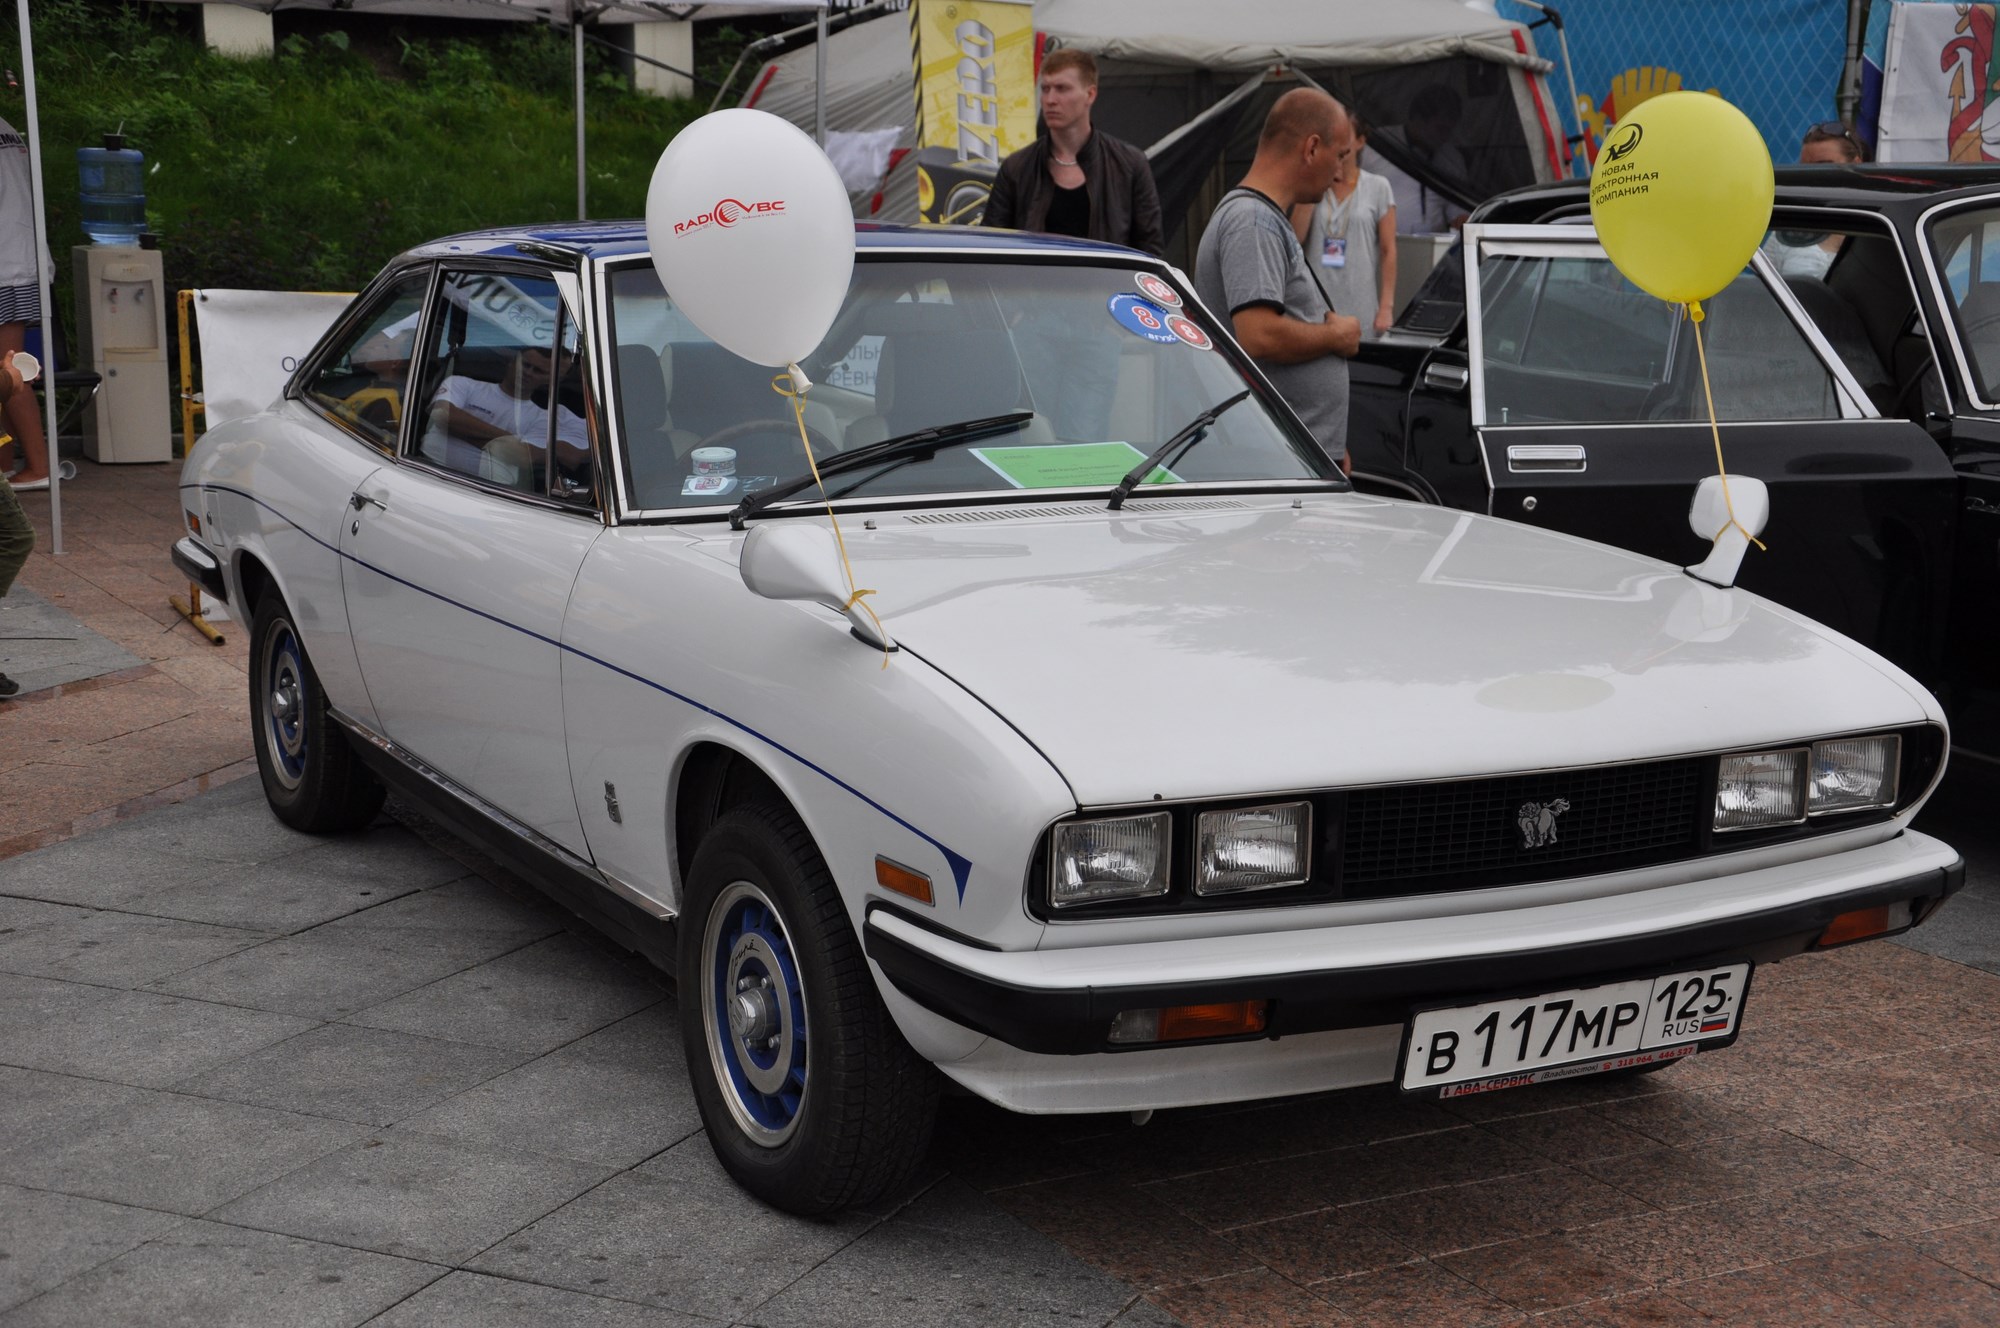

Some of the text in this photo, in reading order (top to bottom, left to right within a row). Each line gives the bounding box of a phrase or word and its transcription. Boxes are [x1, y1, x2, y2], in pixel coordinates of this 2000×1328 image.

[956, 19, 999, 167] ZERO
[1601, 162, 1635, 178] НОВАЯ
[1591, 171, 1659, 197] ЭЛЕКТРОННАЯ
[1596, 185, 1649, 207] КОМПАНИЯ
[1131, 305, 1161, 329] 8
[1180, 324, 1198, 340] 8
[1656, 971, 1732, 1022] 125
[1661, 1019, 1700, 1039] RUS
[1453, 1073, 1536, 1096] АВА-СЕРВИС
[1541, 1063, 1599, 1081] (Владивосток)
